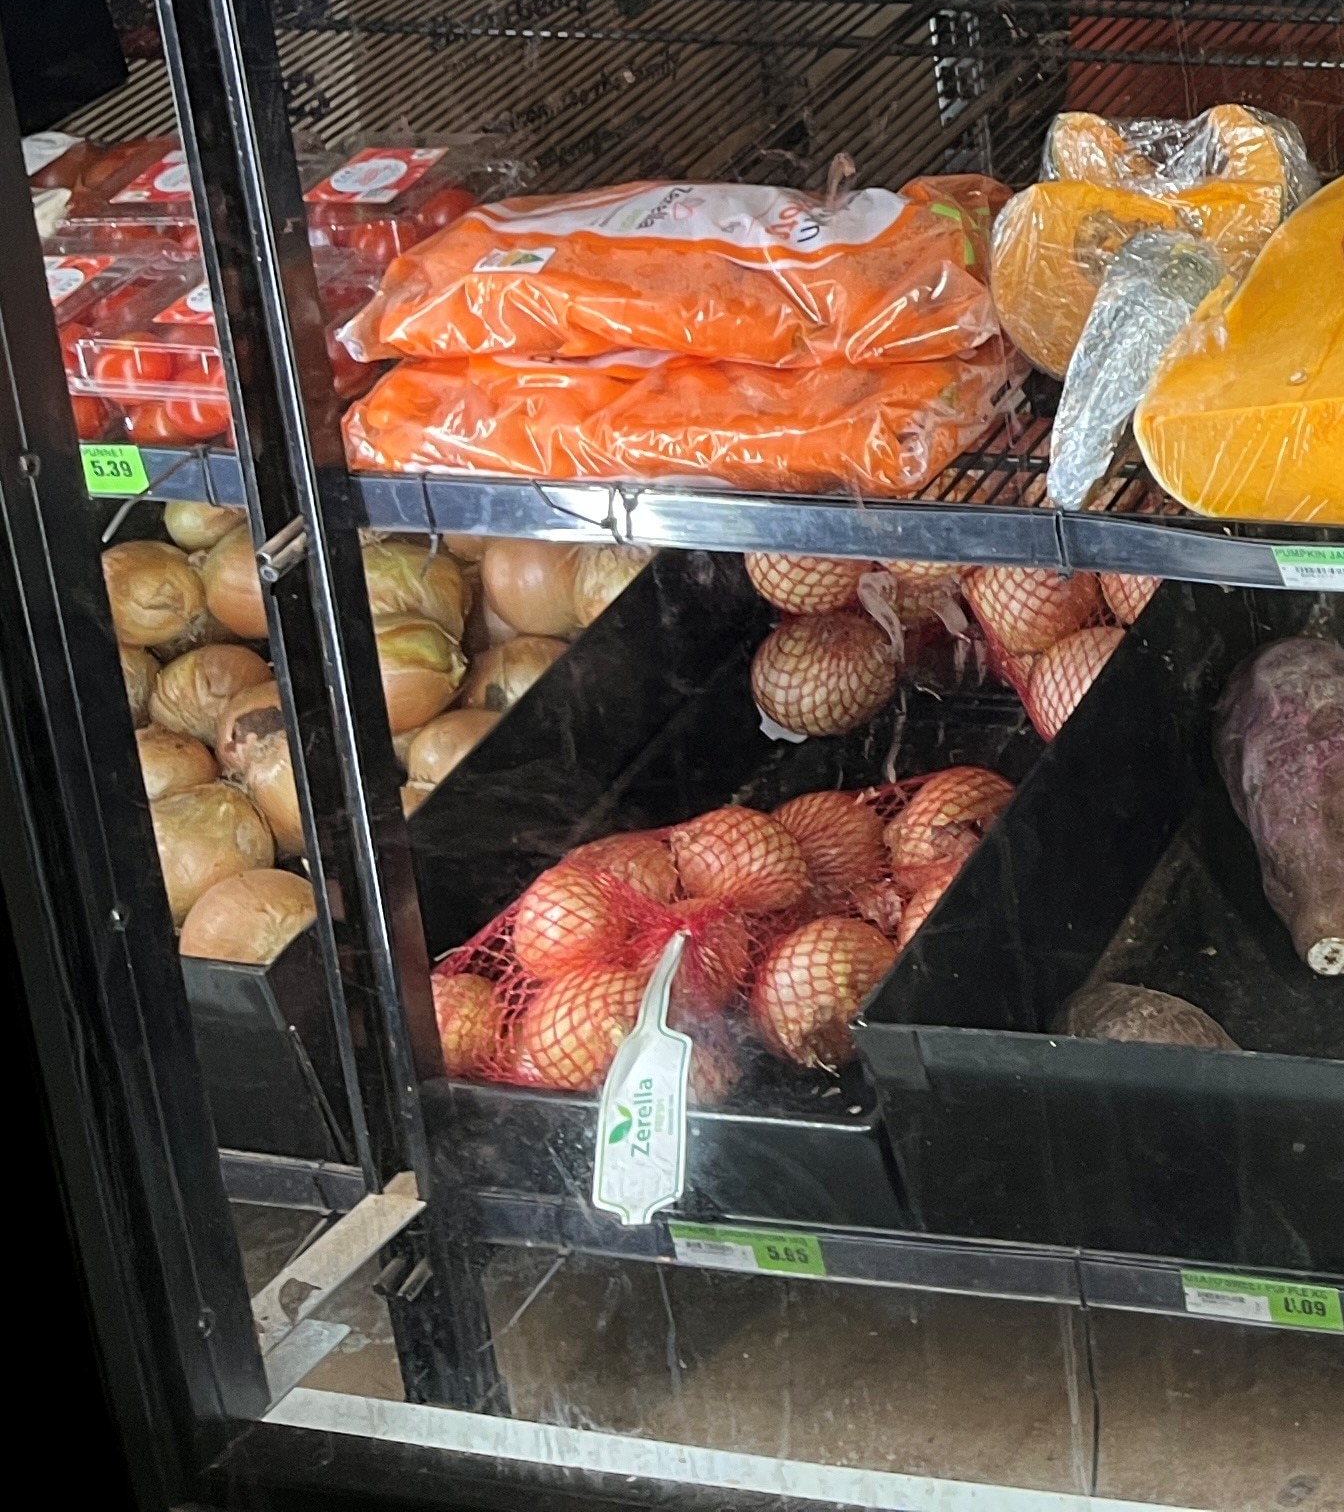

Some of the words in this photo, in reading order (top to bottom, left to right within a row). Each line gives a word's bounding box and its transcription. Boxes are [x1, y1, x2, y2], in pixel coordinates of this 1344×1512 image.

[91, 460, 133, 478] 5.39
[1275, 548, 1326, 559] PUMPKIN
[630, 1077, 653, 1159] Zerella
